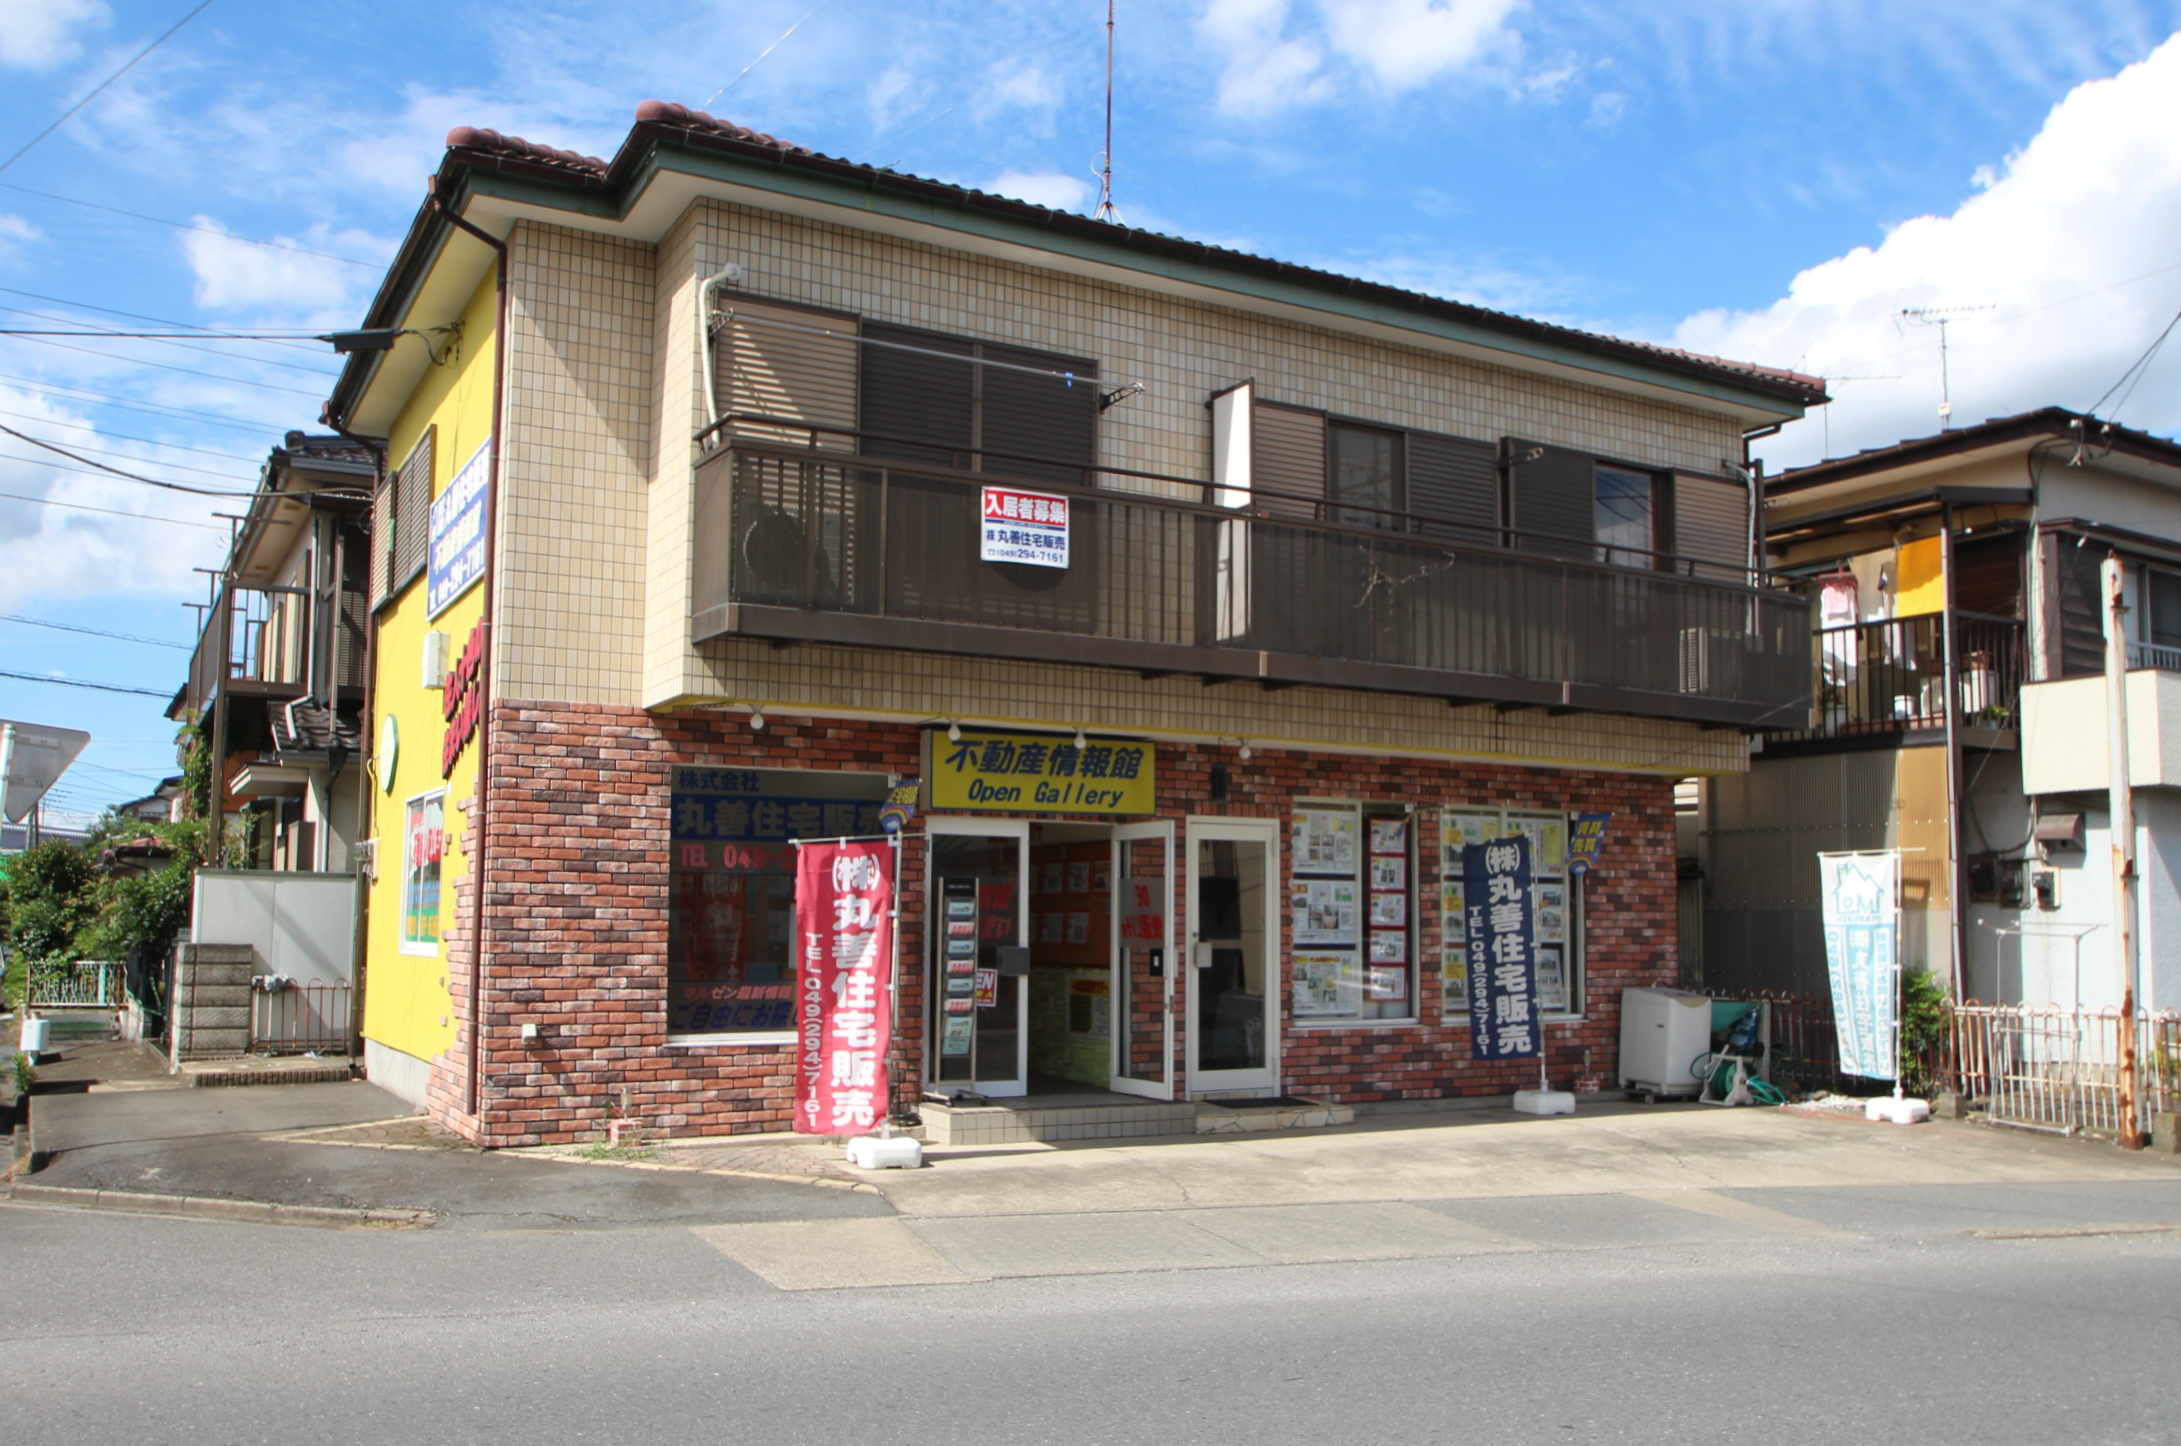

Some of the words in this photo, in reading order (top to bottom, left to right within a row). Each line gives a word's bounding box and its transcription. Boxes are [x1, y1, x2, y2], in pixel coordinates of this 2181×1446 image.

[985, 494, 1065, 523] 入居者募集
[945, 738, 1144, 780] 不動産情報館
[679, 768, 760, 792] 株式会社
[968, 778, 1021, 803] Open
[1034, 780, 1124, 808] Gallery
